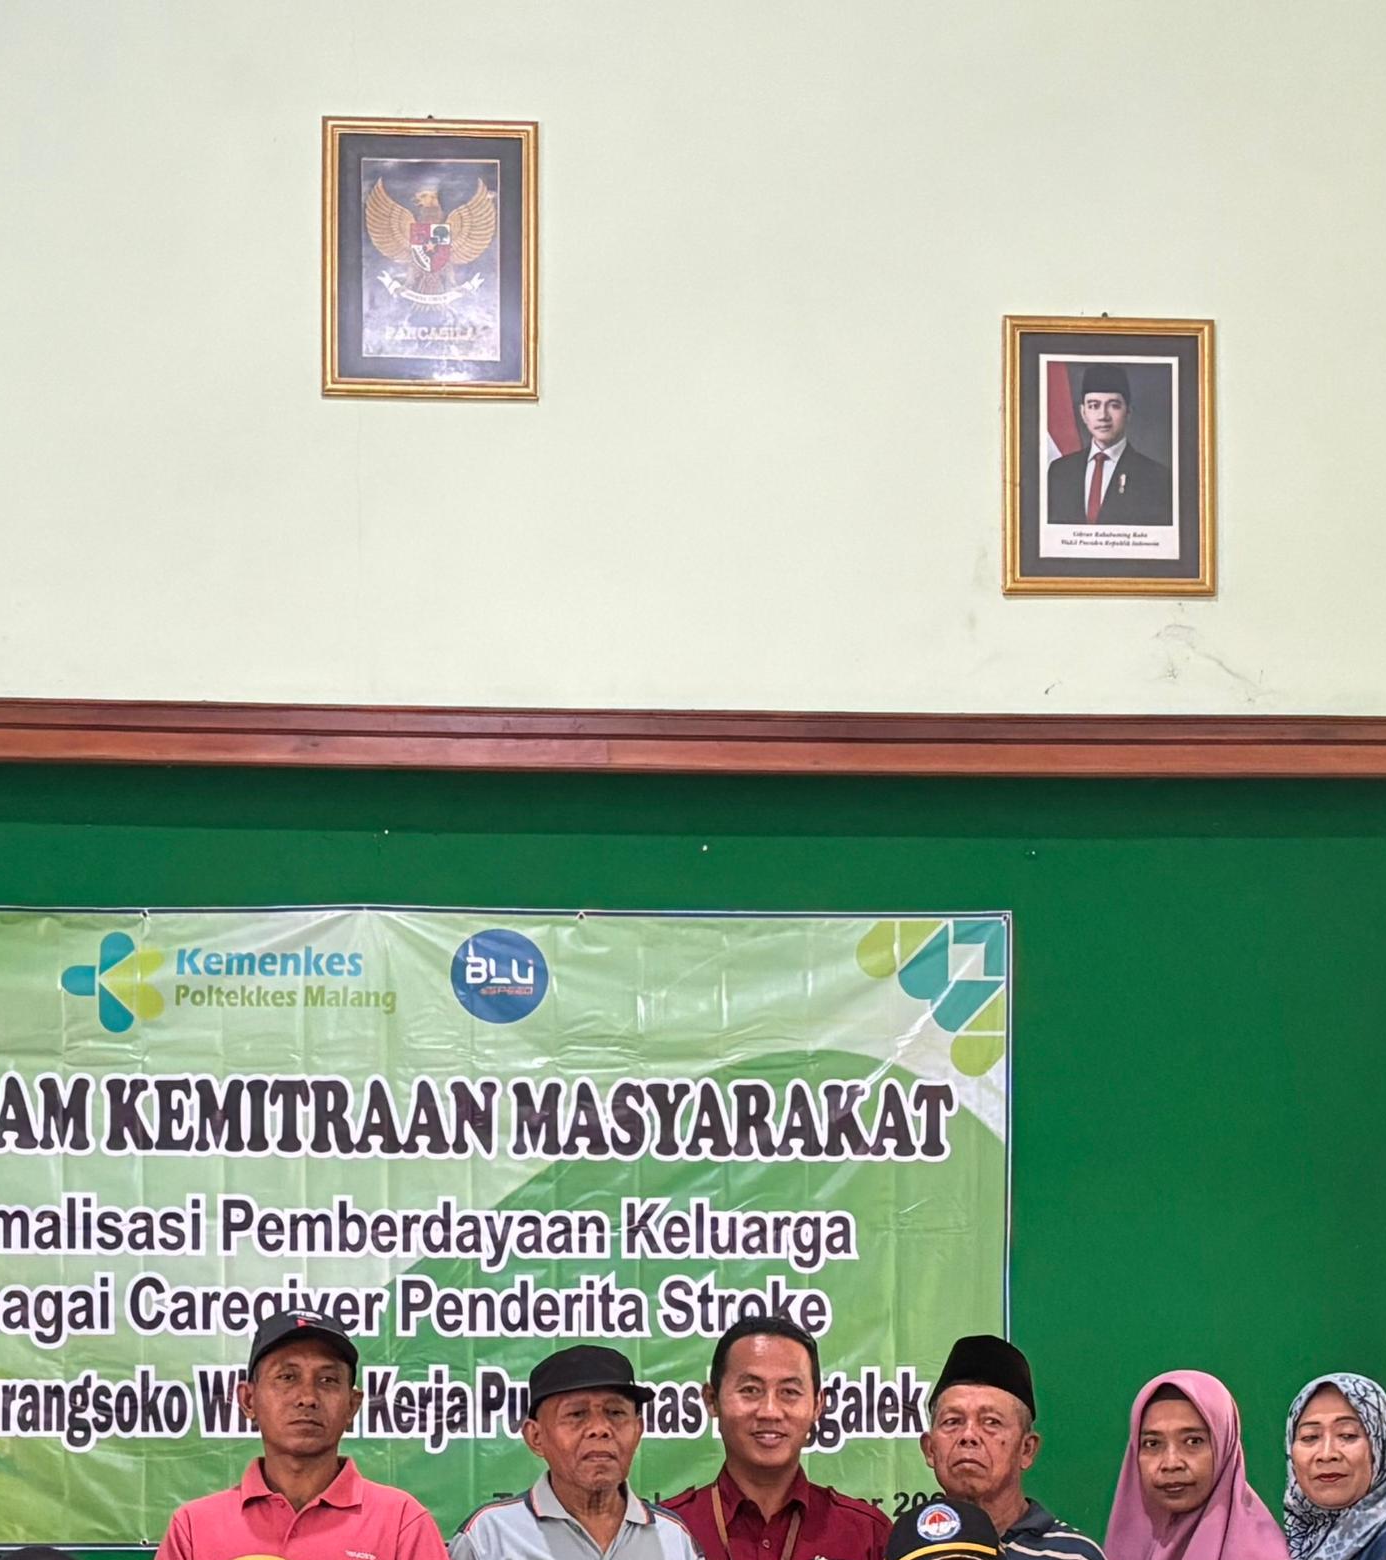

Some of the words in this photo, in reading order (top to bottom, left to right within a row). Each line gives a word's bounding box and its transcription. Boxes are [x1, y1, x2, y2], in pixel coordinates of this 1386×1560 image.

[175, 946, 364, 977] Kemenkes
[174, 984, 298, 1008] Poltekkes
[303, 984, 398, 1015] Malang
[106, 1077, 496, 1154] KEMITRAAN
[512, 1082, 954, 1157] MASYARAKAT
[223, 1199, 605, 1267] Pemberdayaan
[627, 1199, 852, 1268] Keluarga
[401, 1280, 644, 1332] Penderita
[368, 1370, 468, 1448] Kerja
